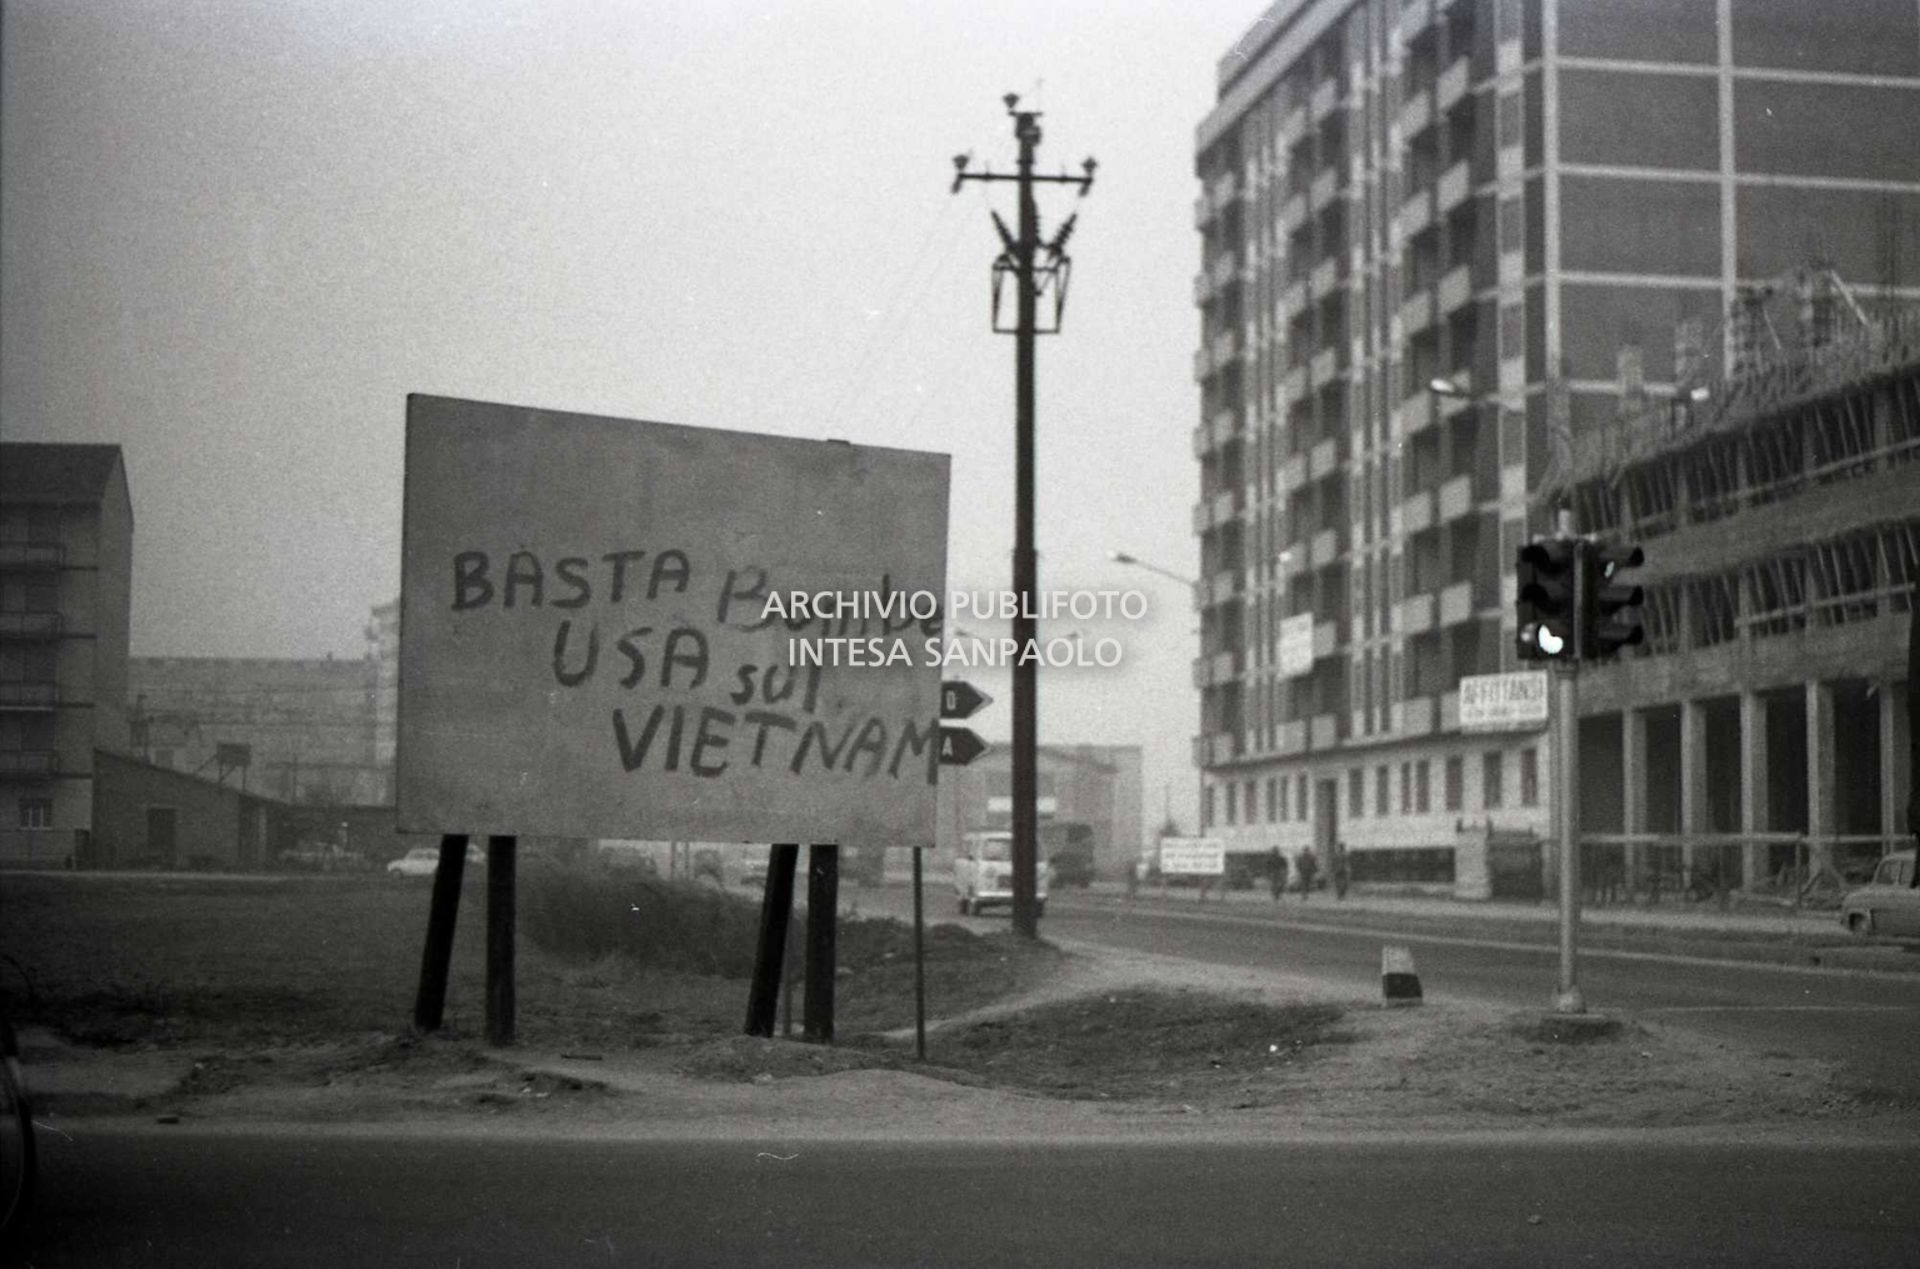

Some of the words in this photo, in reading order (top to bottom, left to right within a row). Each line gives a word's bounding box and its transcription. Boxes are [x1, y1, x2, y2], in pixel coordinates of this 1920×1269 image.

[452, 549, 691, 611] BASTA
[553, 619, 710, 689] USA
[613, 705, 940, 786] VIETNAM
